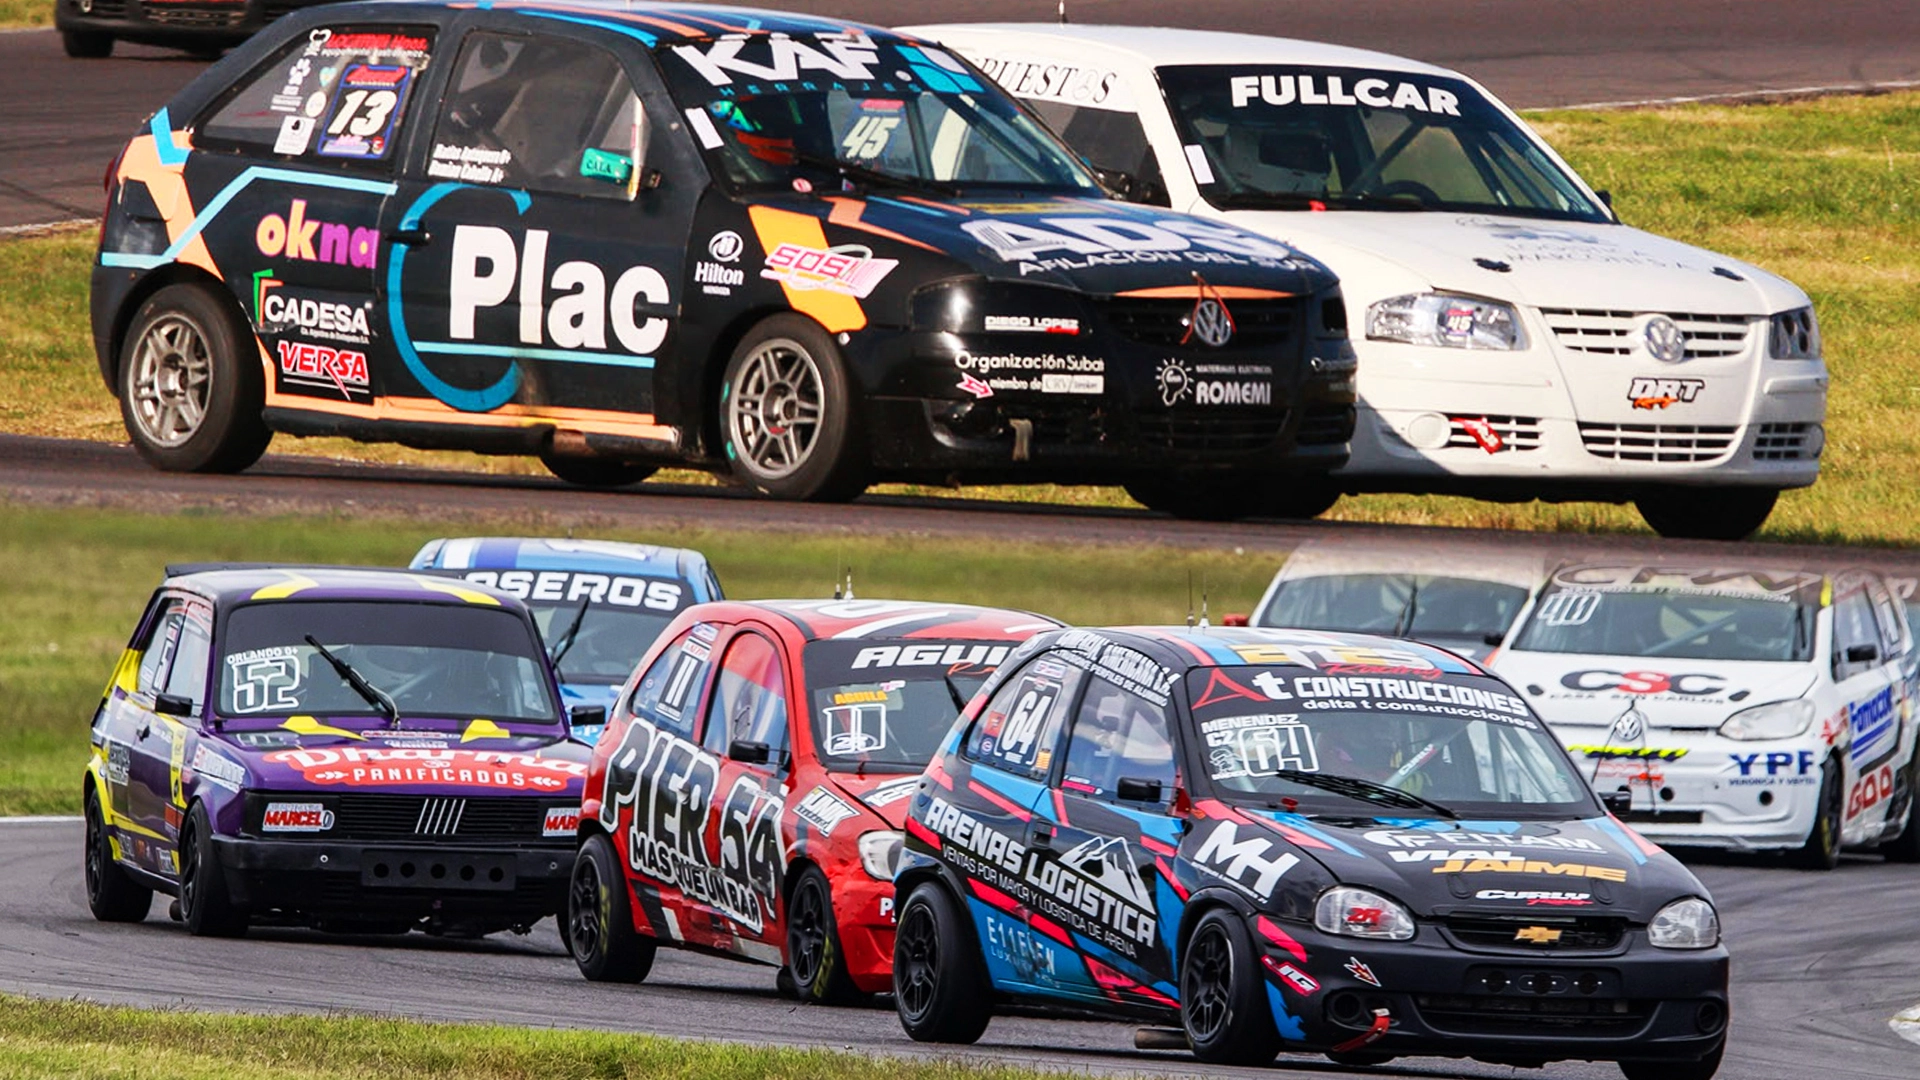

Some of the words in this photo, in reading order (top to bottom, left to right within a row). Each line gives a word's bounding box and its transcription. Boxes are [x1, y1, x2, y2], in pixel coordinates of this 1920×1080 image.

[974, 56, 1117, 104] PUESTOS
[1230, 75, 1462, 117] FULLCAR
[327, 90, 397, 136] 13
[842, 115, 900, 159] 45
[256, 199, 380, 269] okna
[960, 217, 1289, 263] ADS
[694, 261, 744, 286] Hilton
[1185, 251, 1240, 266] DEL
[1260, 256, 1322, 273] SUR
[450, 224, 670, 355] Plac
[264, 294, 371, 336] CADESA
[985, 315, 1031, 327] DIEGO
[1033, 316, 1079, 328] LOPEZ
[278, 340, 370, 401] VERSA
[1030, 377, 1042, 390] de
[1195, 381, 1271, 405] ROMEMI
[1627, 377, 1705, 403] DRT
[226, 647, 282, 665] ORLANDO
[851, 645, 1020, 669] AGUI
[231, 655, 301, 714] 52
[1560, 669, 1728, 695] CSC
[833, 690, 888, 705] AGUILA
[1293, 677, 1530, 717] CONSTRUCCIONES
[1302, 698, 1358, 711] delta
[1360, 699, 1373, 710] t
[1001, 690, 1052, 755] 64
[1201, 713, 1300, 734] MENENDEZ
[276, 746, 588, 776] Dharma
[1728, 751, 1815, 776] YPF
[353, 767, 525, 787] PANIFICADOS
[1388, 850, 1526, 862] VIAL
[924, 797, 1026, 876] ARENAS
[1024, 852, 1157, 948] LOGISTICA
[1432, 860, 1628, 883] JAIME
[941, 843, 977, 874] VENTAS
[977, 862, 997, 882] POR
[998, 872, 1031, 903] MAYOR
[1038, 895, 1087, 933] LOGISTICA
[1087, 920, 1103, 941] DE
[1103, 931, 1138, 959] ARENA
[1475, 889, 1592, 901] CURLY
